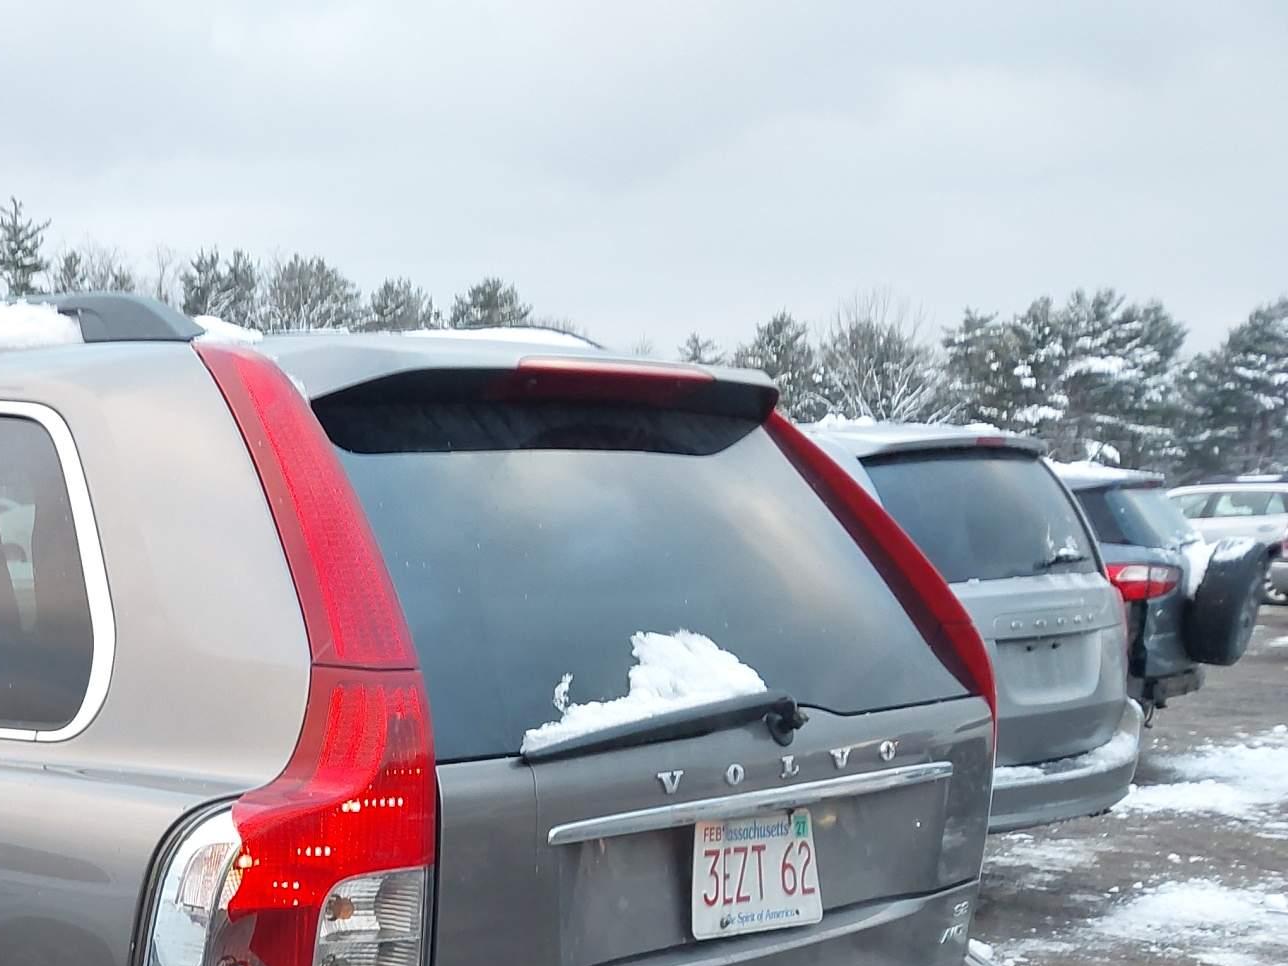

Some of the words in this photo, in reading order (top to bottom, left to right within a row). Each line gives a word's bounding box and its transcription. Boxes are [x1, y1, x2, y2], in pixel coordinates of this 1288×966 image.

[657, 740, 899, 794] VOLVO
[703, 827, 722, 842] FEB
[796, 820, 807, 837] 27
[702, 844, 766, 906] 3EZT
[780, 841, 816, 896] 62
